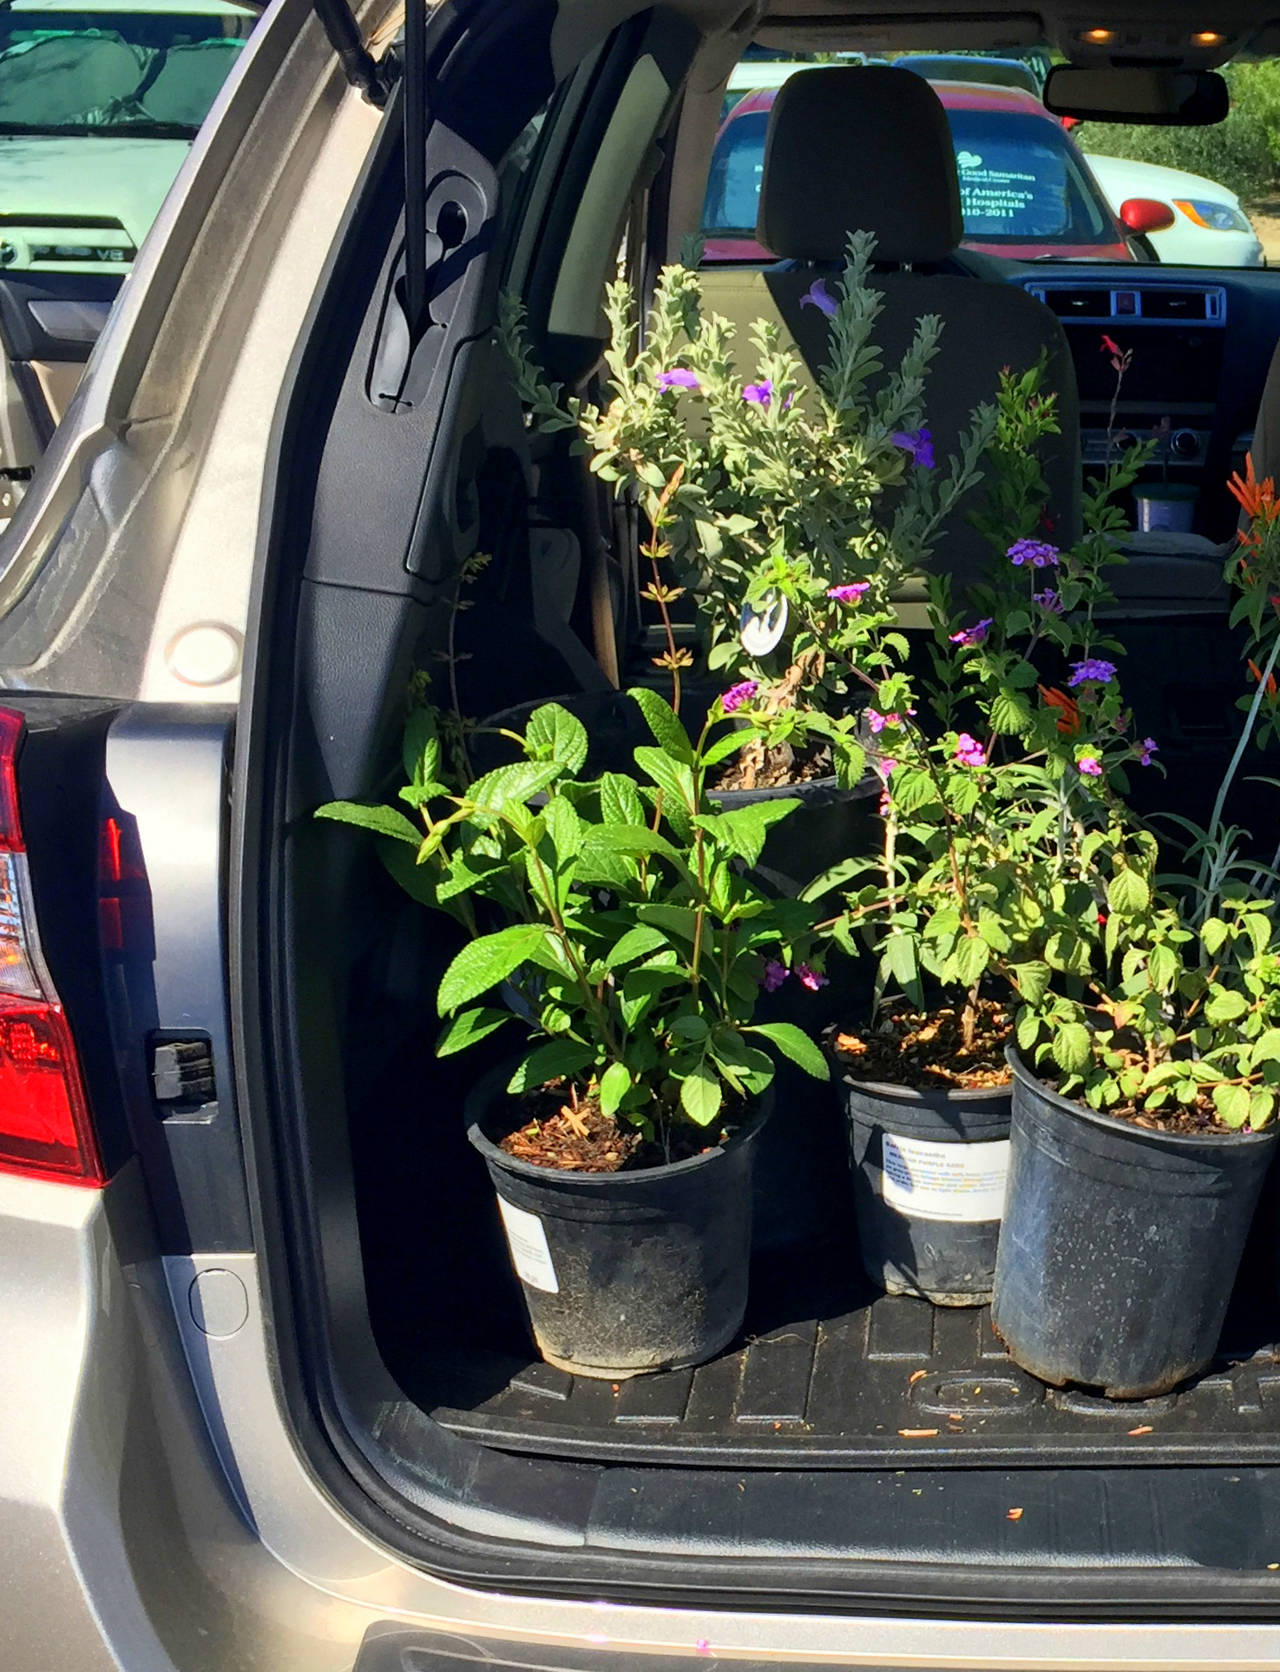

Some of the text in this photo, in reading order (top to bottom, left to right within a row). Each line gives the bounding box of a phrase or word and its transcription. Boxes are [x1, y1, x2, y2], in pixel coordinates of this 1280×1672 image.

[961, 169, 1036, 182] Good Samaritan
[972, 187, 1034, 200] America's
[966, 197, 1026, 209] Hospitals
